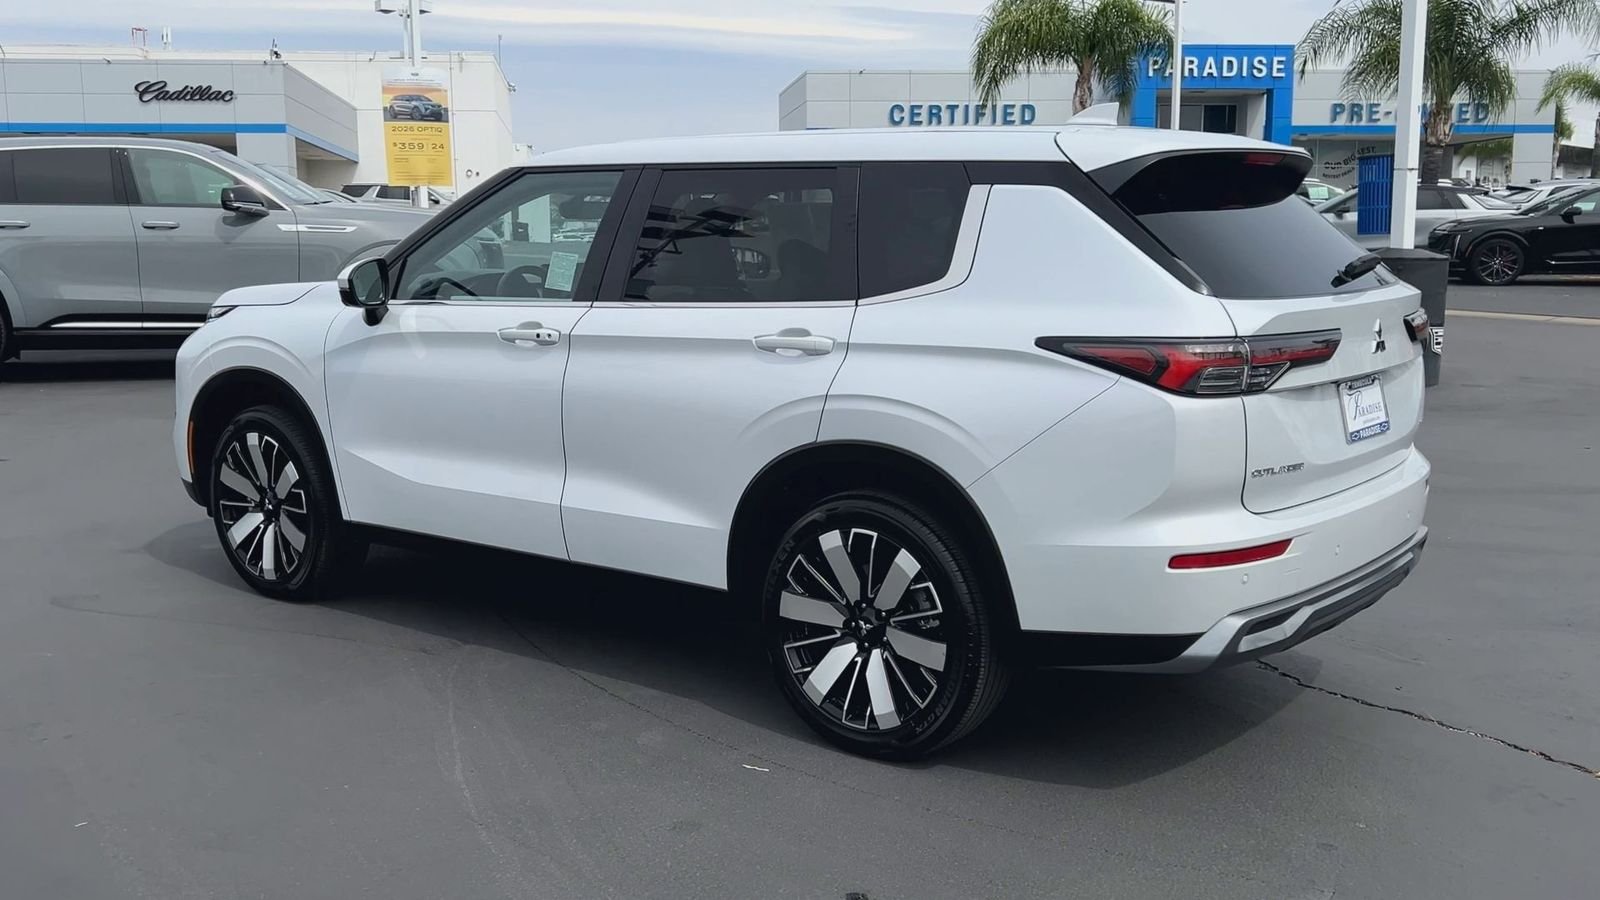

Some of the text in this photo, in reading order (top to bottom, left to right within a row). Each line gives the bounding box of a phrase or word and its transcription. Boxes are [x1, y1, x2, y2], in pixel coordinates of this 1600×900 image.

[1148, 56, 1286, 77] PARADISE
[134, 80, 234, 103] Cadillac
[888, 104, 1036, 126] CERTIFIED
[1330, 103, 1490, 123] PRE-ED
